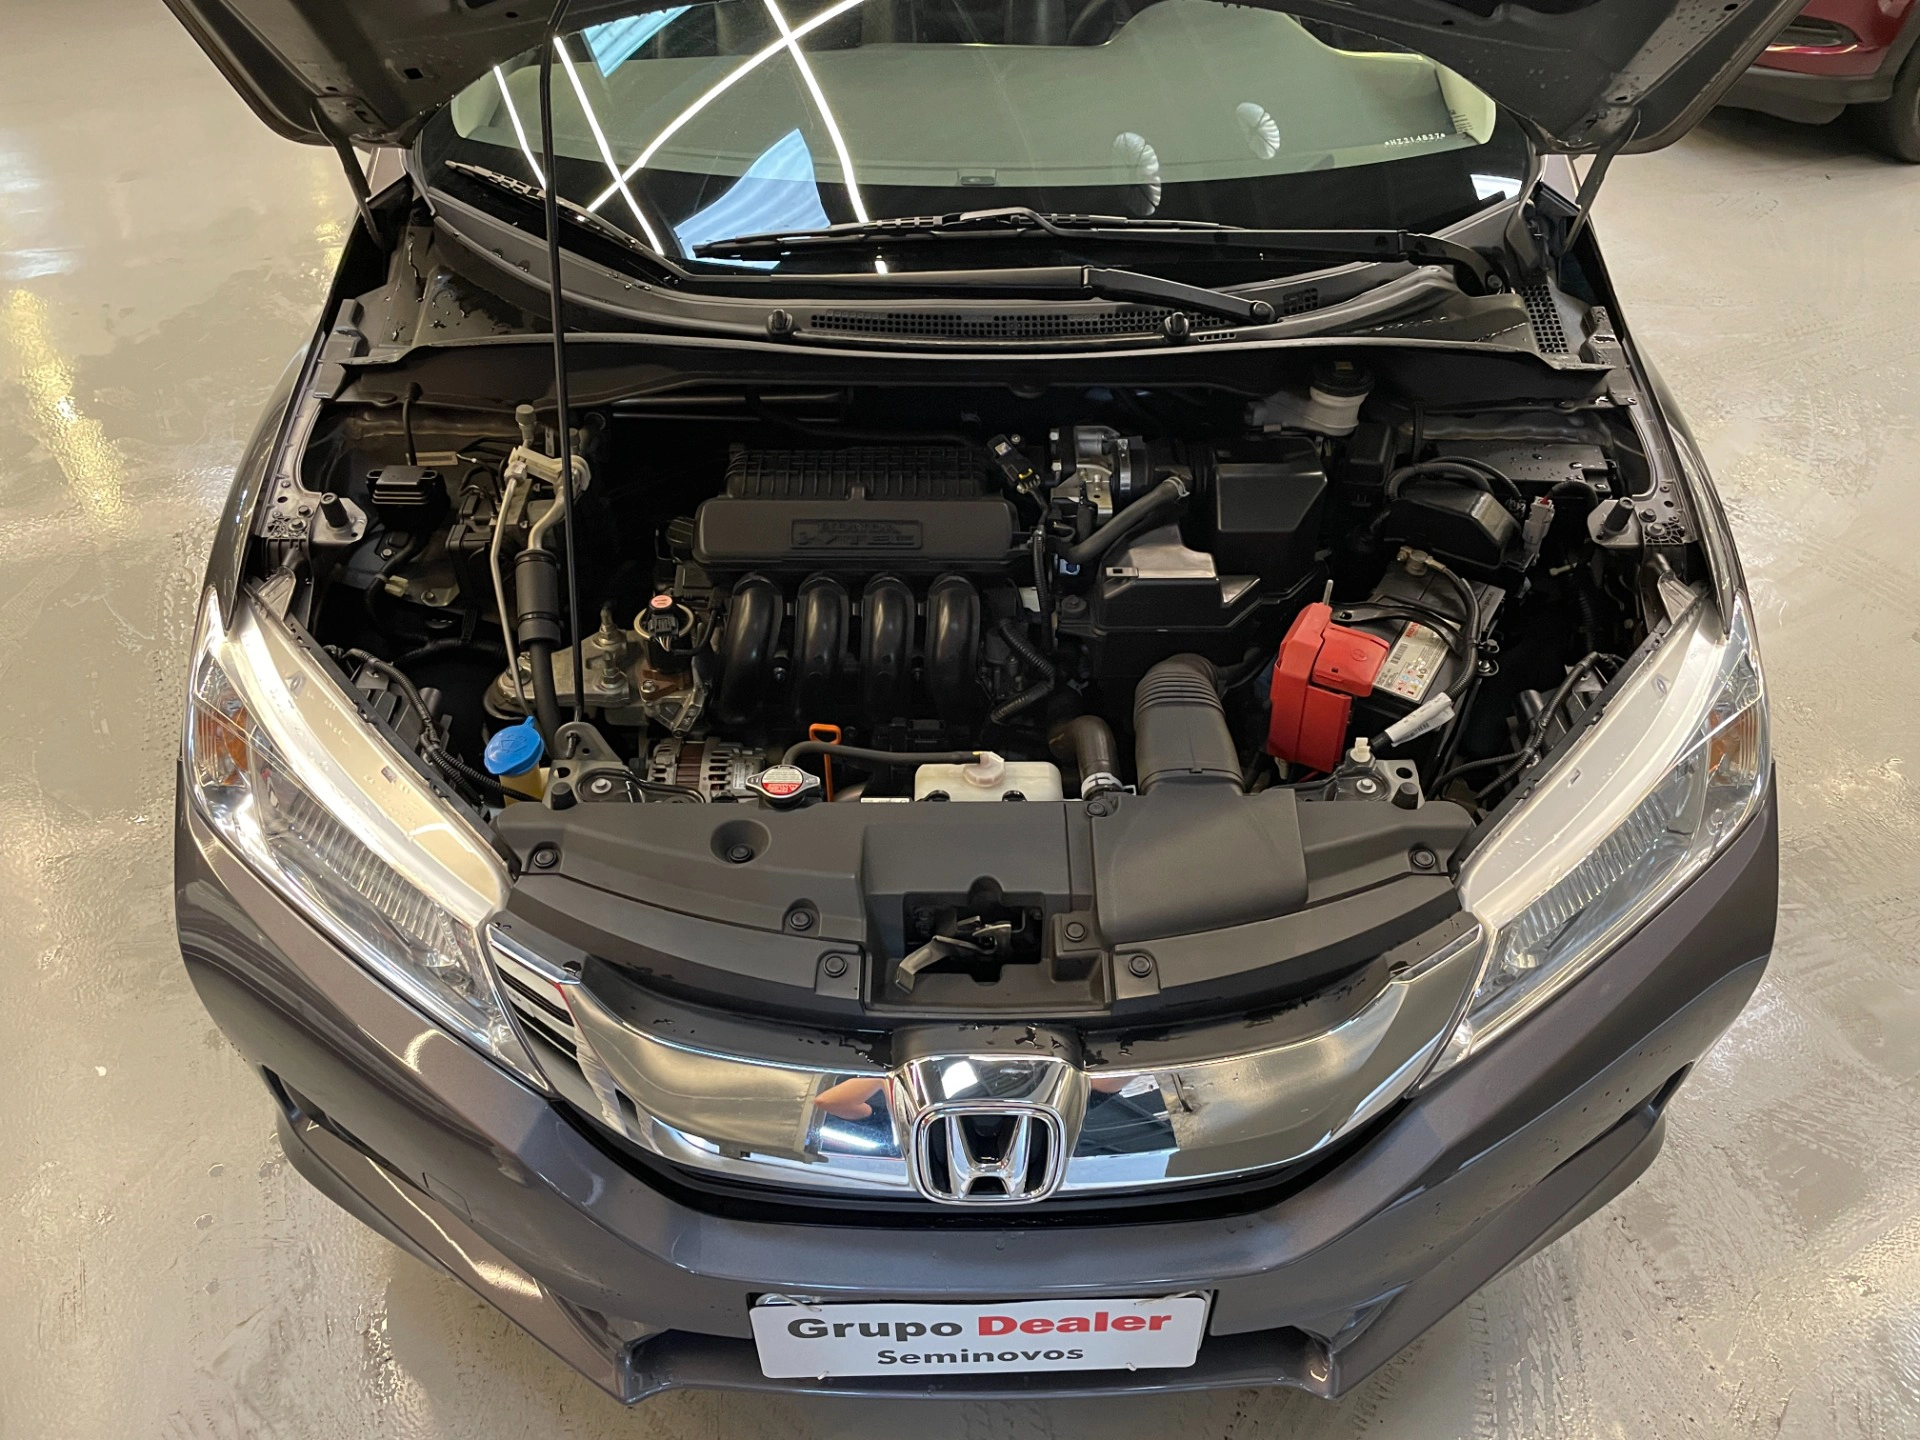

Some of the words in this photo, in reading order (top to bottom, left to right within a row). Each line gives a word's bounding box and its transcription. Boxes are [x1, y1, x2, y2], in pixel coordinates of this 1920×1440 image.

[787, 1318, 963, 1341] Grupo
[978, 1311, 1173, 1336] Dealer
[877, 1346, 1084, 1365] Seminovos
